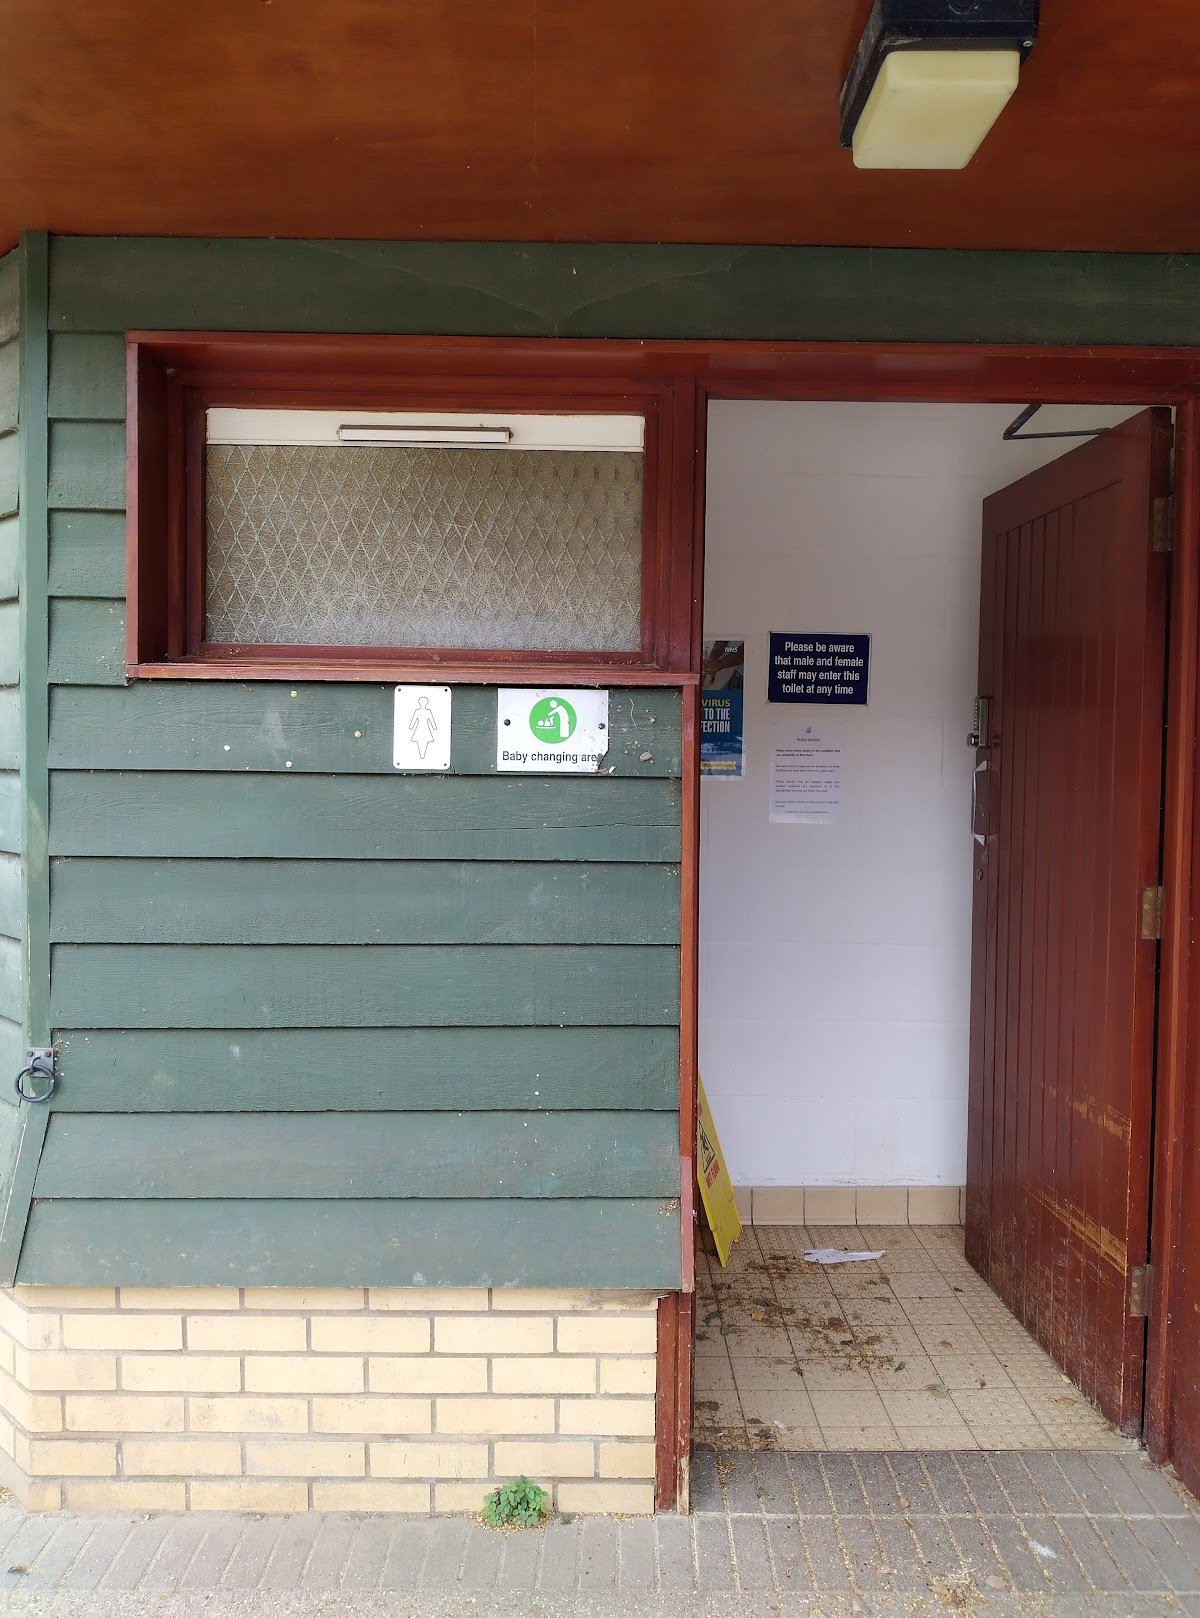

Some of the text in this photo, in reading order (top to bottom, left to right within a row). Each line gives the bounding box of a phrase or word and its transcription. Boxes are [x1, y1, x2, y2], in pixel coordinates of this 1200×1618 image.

[784, 641, 855, 653] Please be aware
[774, 655, 864, 667] that male and female
[777, 669, 860, 682] staff may enter this
[782, 683, 854, 696] toilet at any time
[704, 708, 730, 720] TO THE
[502, 750, 602, 764] Baby changing are
